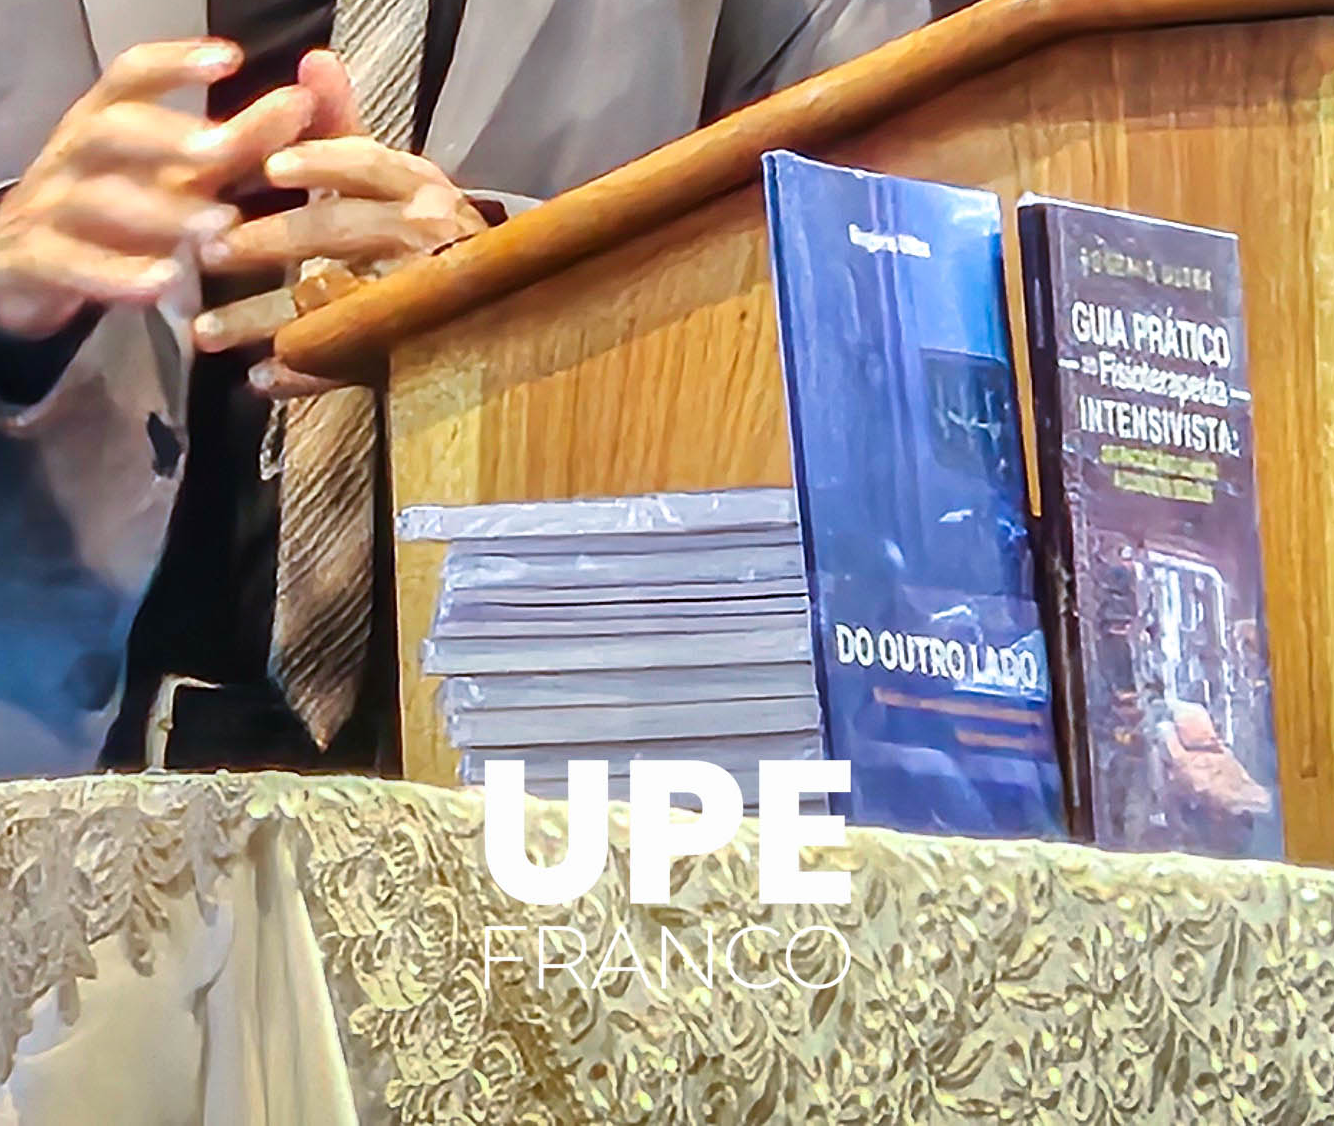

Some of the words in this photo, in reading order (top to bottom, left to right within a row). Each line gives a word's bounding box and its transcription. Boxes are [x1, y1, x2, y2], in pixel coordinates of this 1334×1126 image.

[1071, 300, 1130, 350] GUIA
[1132, 306, 1231, 369] PRÁTICO
[835, 624, 874, 667] DO
[878, 630, 965, 681] OUTRO
[969, 643, 1038, 690] LADO
